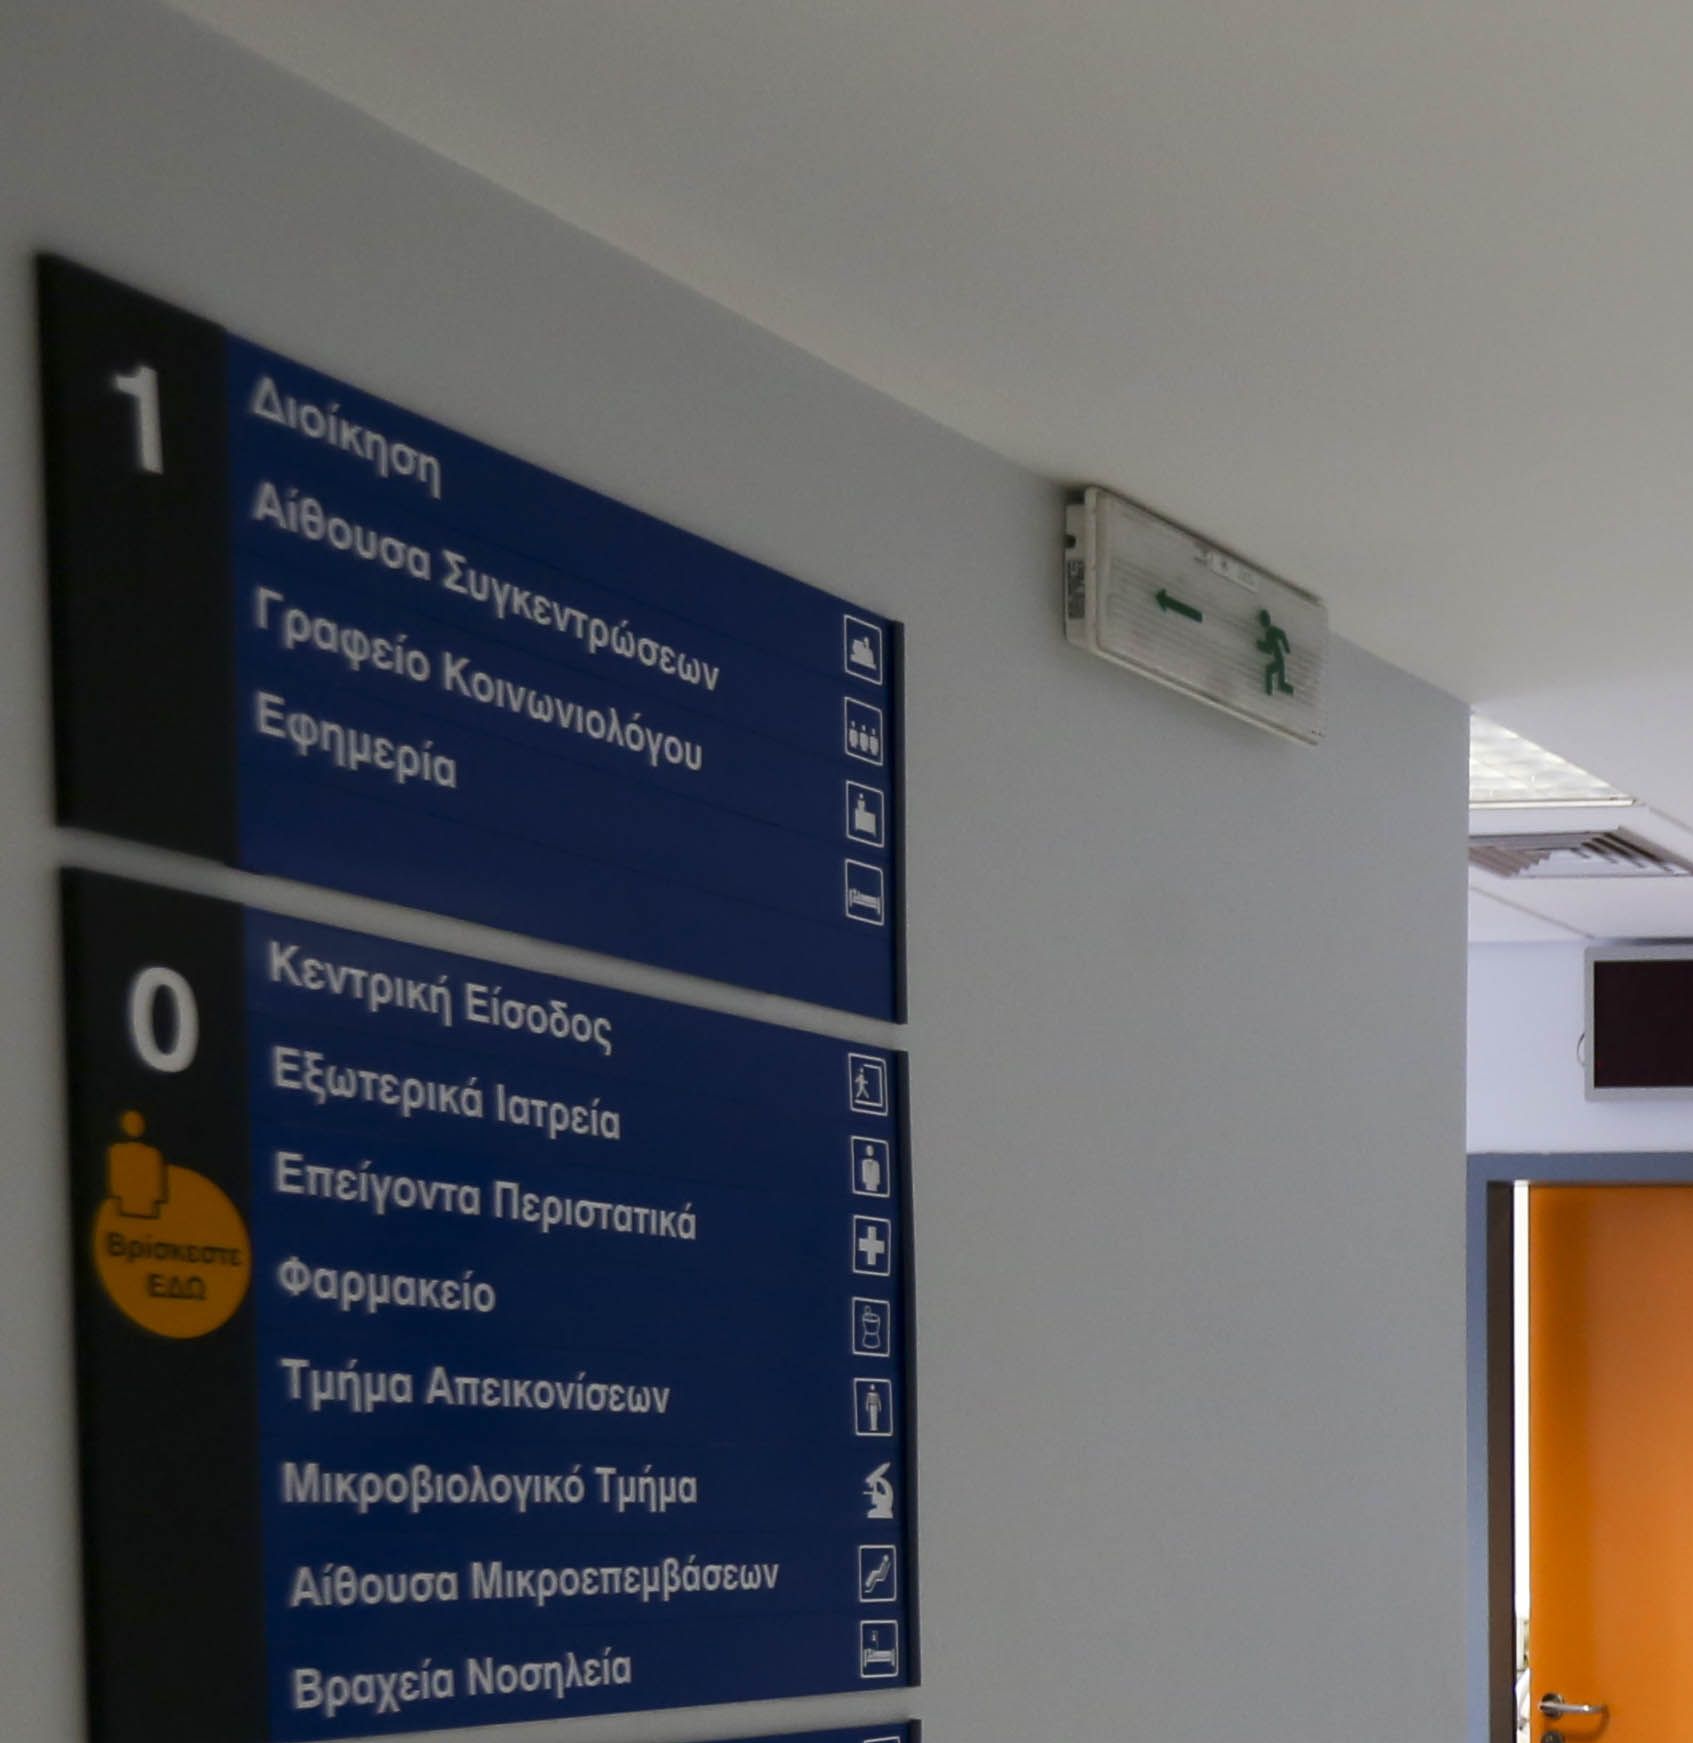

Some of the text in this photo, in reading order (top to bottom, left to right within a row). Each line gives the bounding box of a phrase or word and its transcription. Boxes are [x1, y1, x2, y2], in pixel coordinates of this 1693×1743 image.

[111, 365, 164, 476] 1
[251, 377, 441, 499] Διοίκηση
[252, 482, 720, 693] Αίθουσα Συγκεντρώσεων
[254, 586, 703, 771] Γραφείο Κοινωνιολόγου
[254, 691, 457, 789] Εφημερία
[131, 966, 199, 1073] 0
[266, 940, 612, 1057] Κεντρική Είσοδος
[271, 1045, 621, 1140] Εξωτερικά Ιατρεία
[274, 1150, 697, 1240] Επείγοντα Περιστατικά
[106, 1230, 243, 1267] Βρίσκεστε
[146, 1272, 208, 1301] ΕΔΩ
[276, 1255, 496, 1314] Φαρμακείο
[279, 1357, 671, 1414] Τμήμα Απεικονίσεων
[280, 1461, 698, 1514] Μικροβιολογικό Τμήμα
[288, 1554, 780, 1607] Αίθουσα Μικροεπεμβάσεων
[292, 1646, 632, 1718] Βραχεία Νοσηλεία
